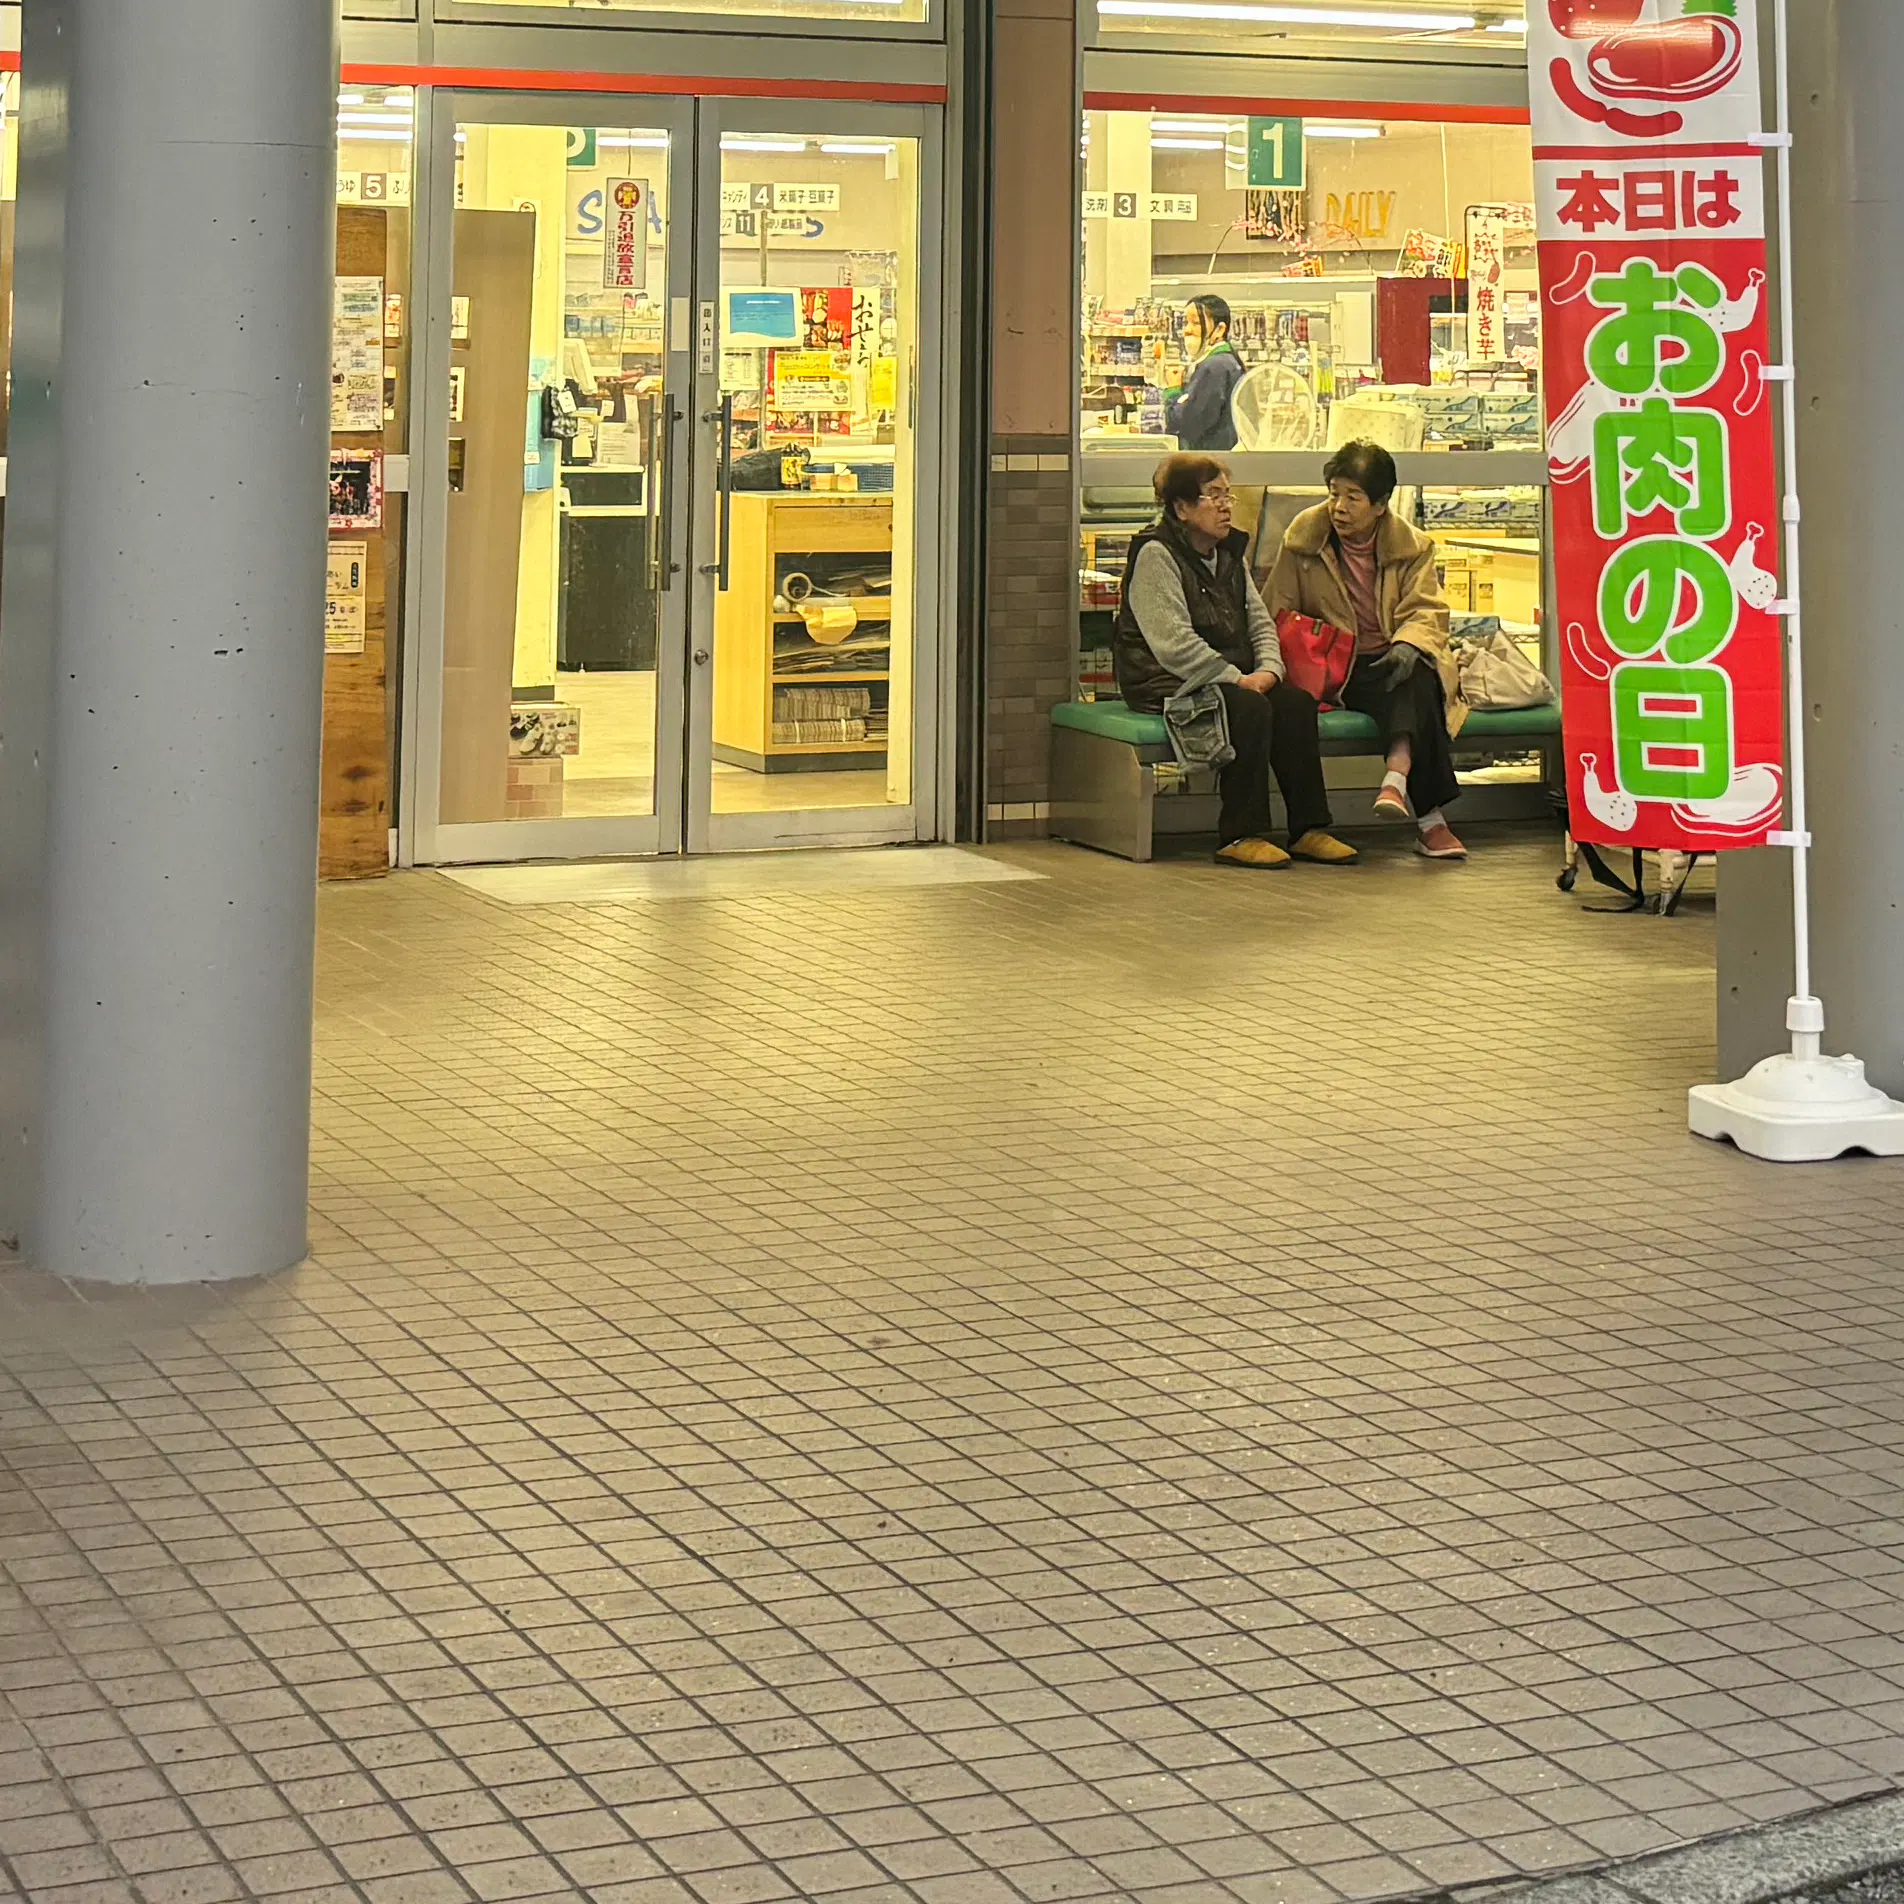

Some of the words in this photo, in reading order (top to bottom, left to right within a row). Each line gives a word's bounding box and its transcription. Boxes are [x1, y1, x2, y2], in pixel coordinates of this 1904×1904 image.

[1262, 122, 1284, 179] 1
[365, 175, 382, 199] 5
[754, 185, 770, 207] 4
[1117, 194, 1132, 216] 3
[1555, 170, 1742, 233] 本日は
[1326, 190, 1396, 238] DAILY
[1477, 286, 1496, 361] 焼き芋
[1586, 260, 1734, 801] お肉の日
